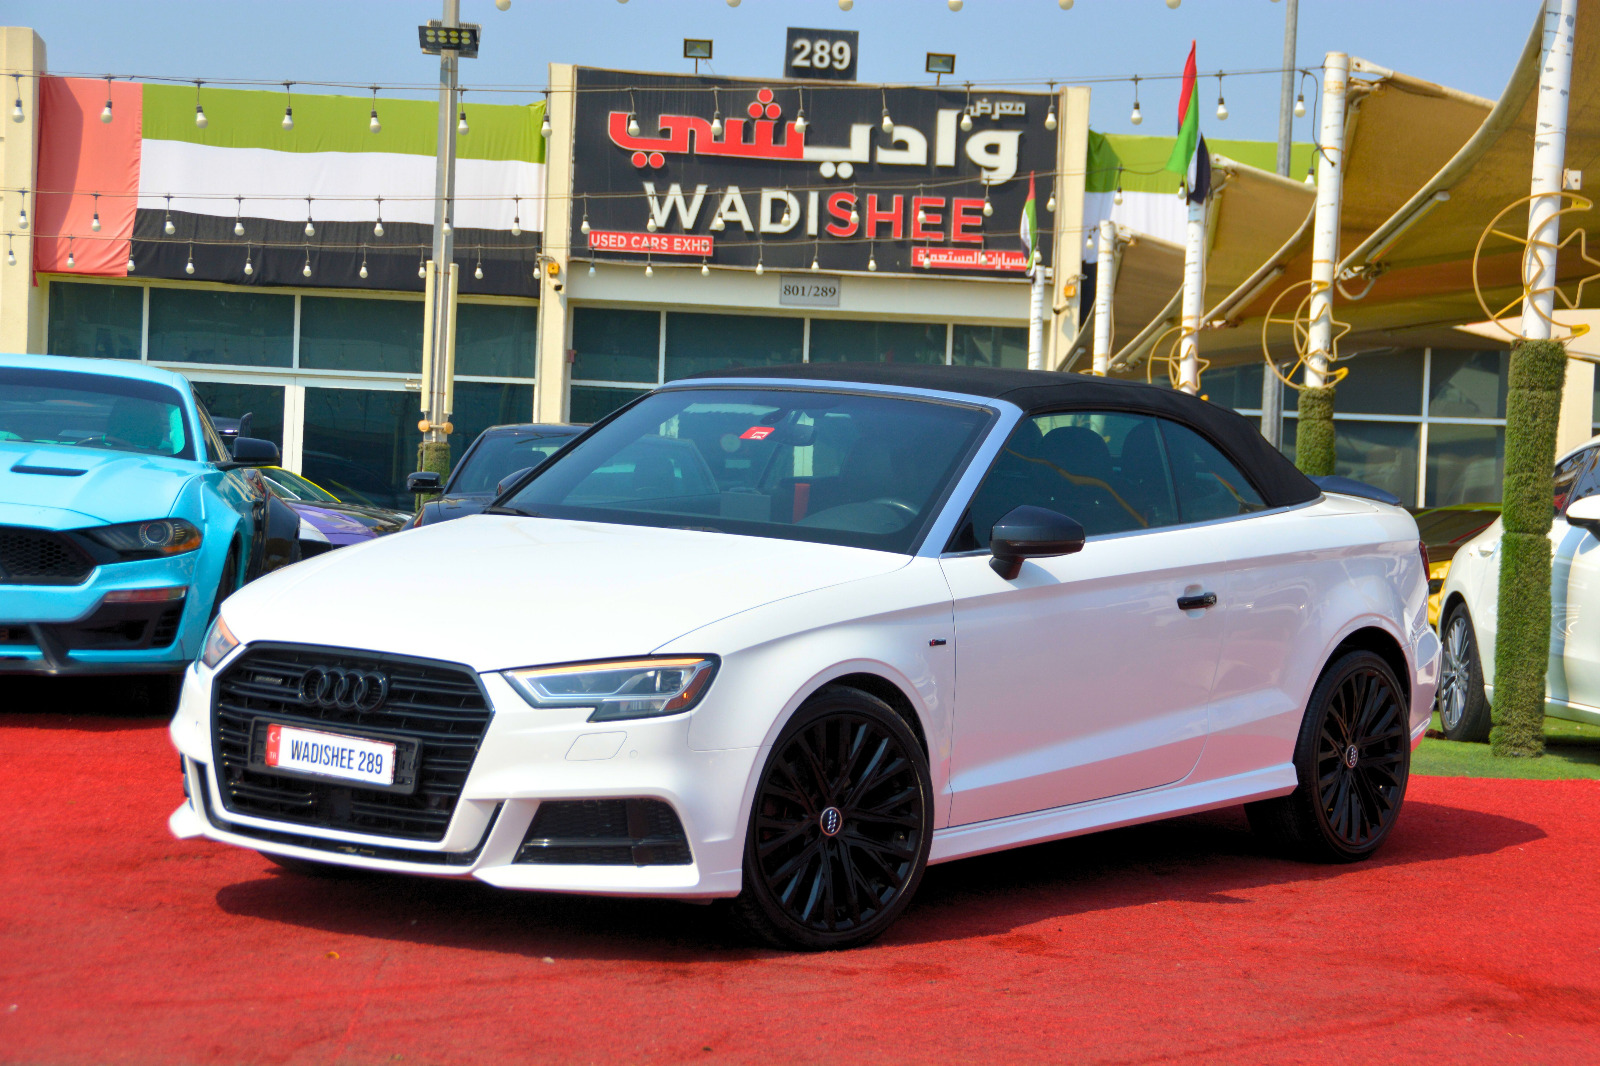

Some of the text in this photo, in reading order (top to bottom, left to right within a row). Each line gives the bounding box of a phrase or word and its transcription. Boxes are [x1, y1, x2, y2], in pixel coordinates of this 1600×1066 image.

[791, 38, 851, 70] 289
[969, 98, 1025, 120] معرض
[643, 181, 986, 244] WADISHEE
[591, 234, 626, 247] USED
[630, 236, 669, 250] CARS
[783, 285, 837, 297] 801/289
[291, 739, 384, 774] WADISHEE 289
